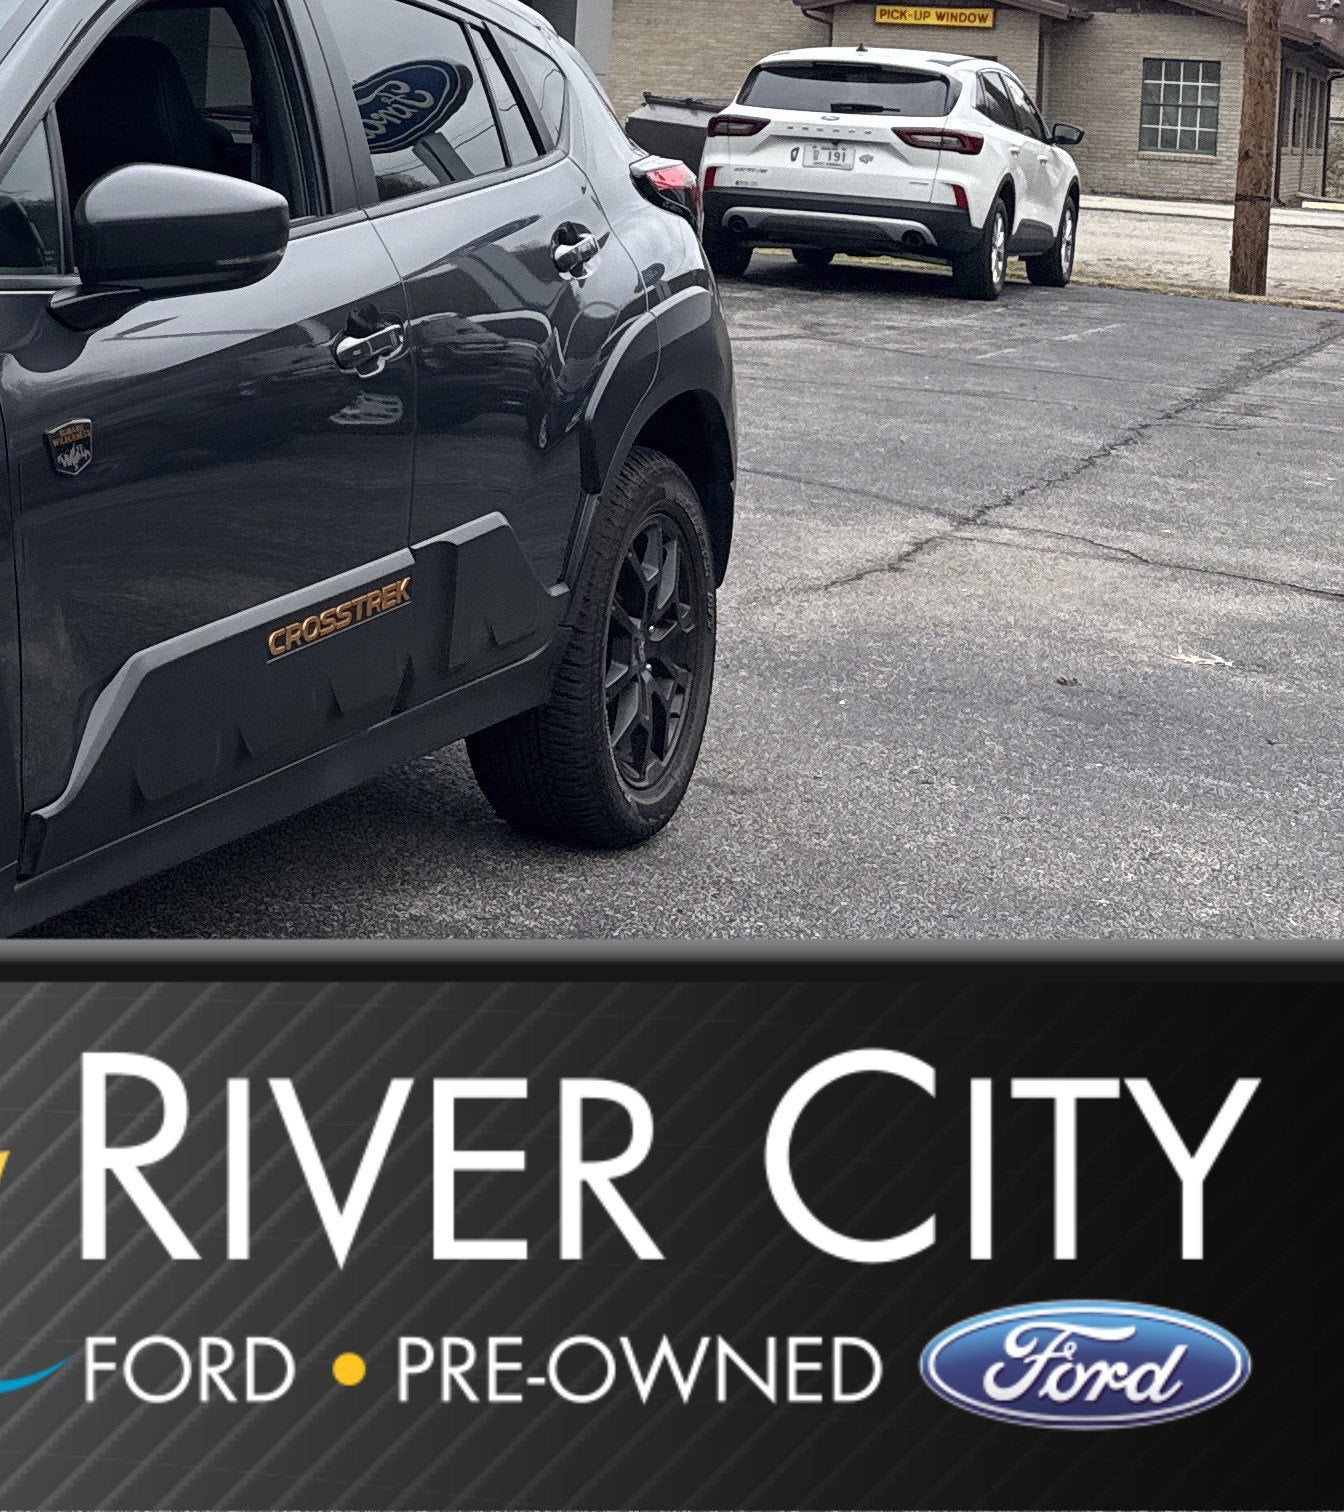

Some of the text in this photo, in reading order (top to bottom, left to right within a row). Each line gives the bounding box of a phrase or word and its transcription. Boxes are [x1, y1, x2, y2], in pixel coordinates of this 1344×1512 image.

[878, 8, 989, 24] PICK-UP WINDOW
[268, 576, 411, 656] CROSSTREK
